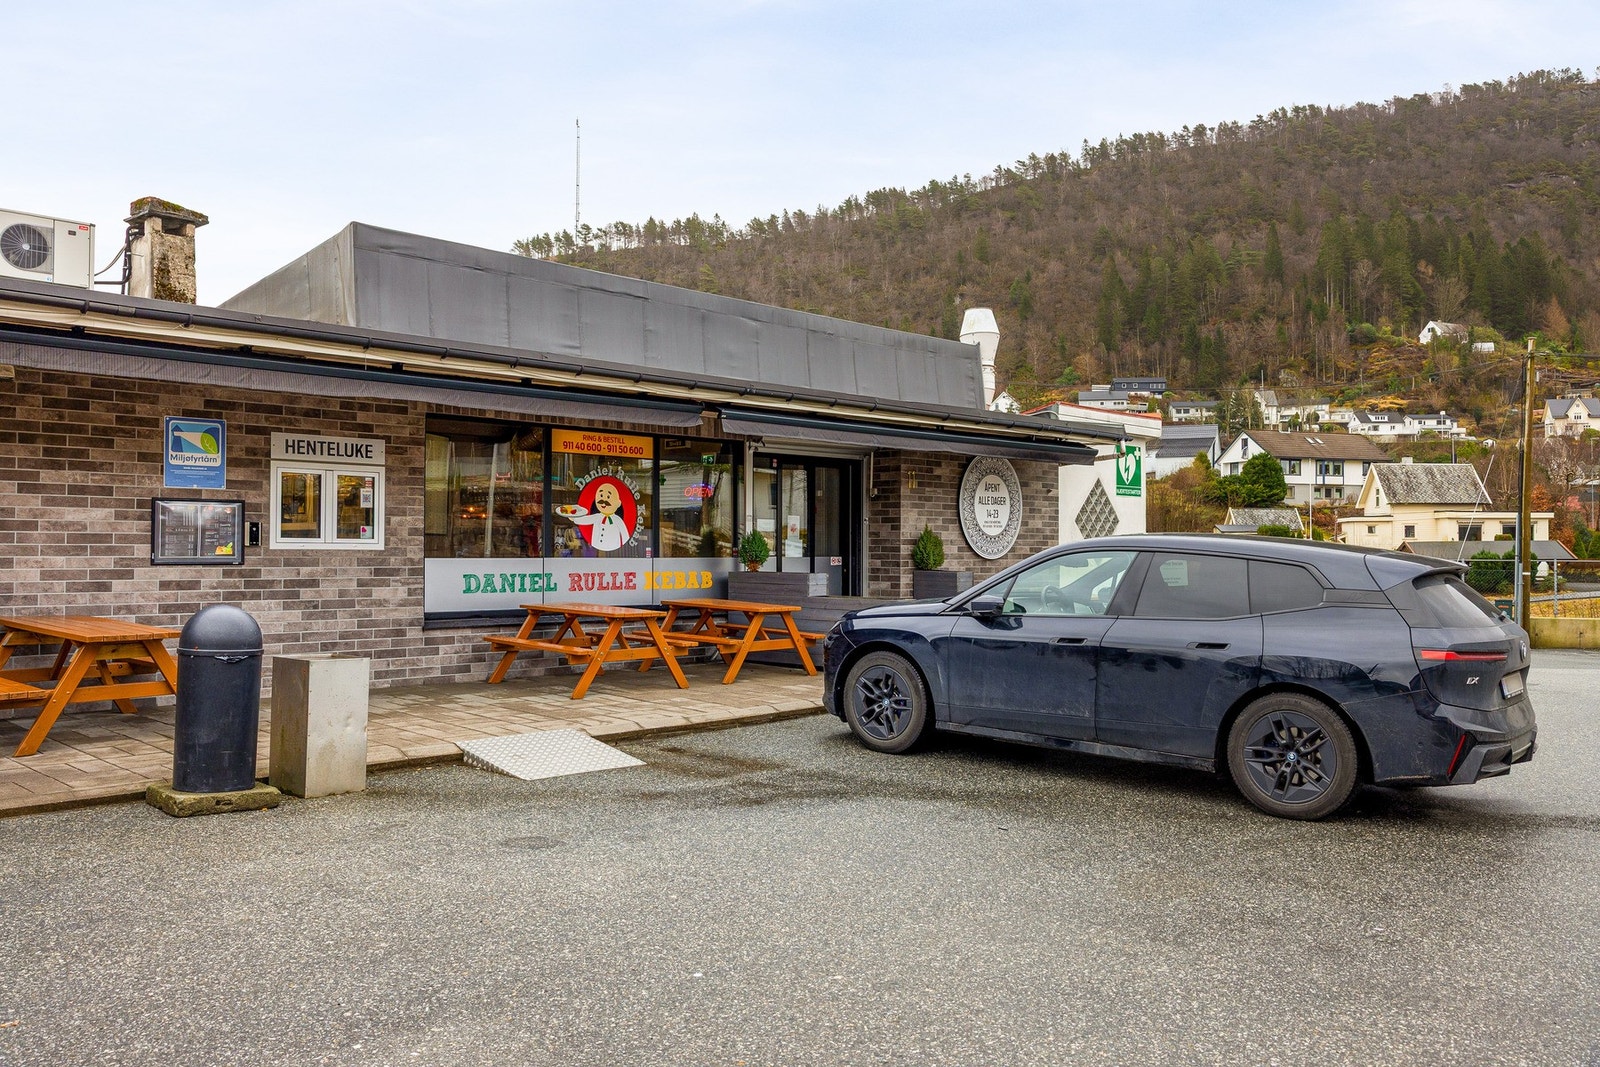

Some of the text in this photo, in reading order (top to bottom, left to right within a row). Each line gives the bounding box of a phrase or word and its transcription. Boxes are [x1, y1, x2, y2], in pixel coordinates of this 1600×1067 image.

[582, 434, 597, 442] RING
[603, 436, 625, 444] BESTILL
[285, 438, 373, 459] HENTELUKE
[563, 441, 574, 450] 911
[575, 442, 585, 450] 40
[586, 443, 602, 452] 600
[607, 444, 617, 453] 911
[618, 445, 628, 454] 50
[629, 446, 644, 455] 600
[170, 454, 218, 464] Miljøfyrtårn
[684, 487, 713, 497] OPEN
[984, 481, 1001, 493] ÅPENT
[575, 465, 646, 547] Daniel Rulle Kebab
[978, 496, 1007, 506] ALLE DAGER
[986, 509, 999, 519] 14-23
[462, 570, 714, 594] DANIEL RULLE KEBAB
